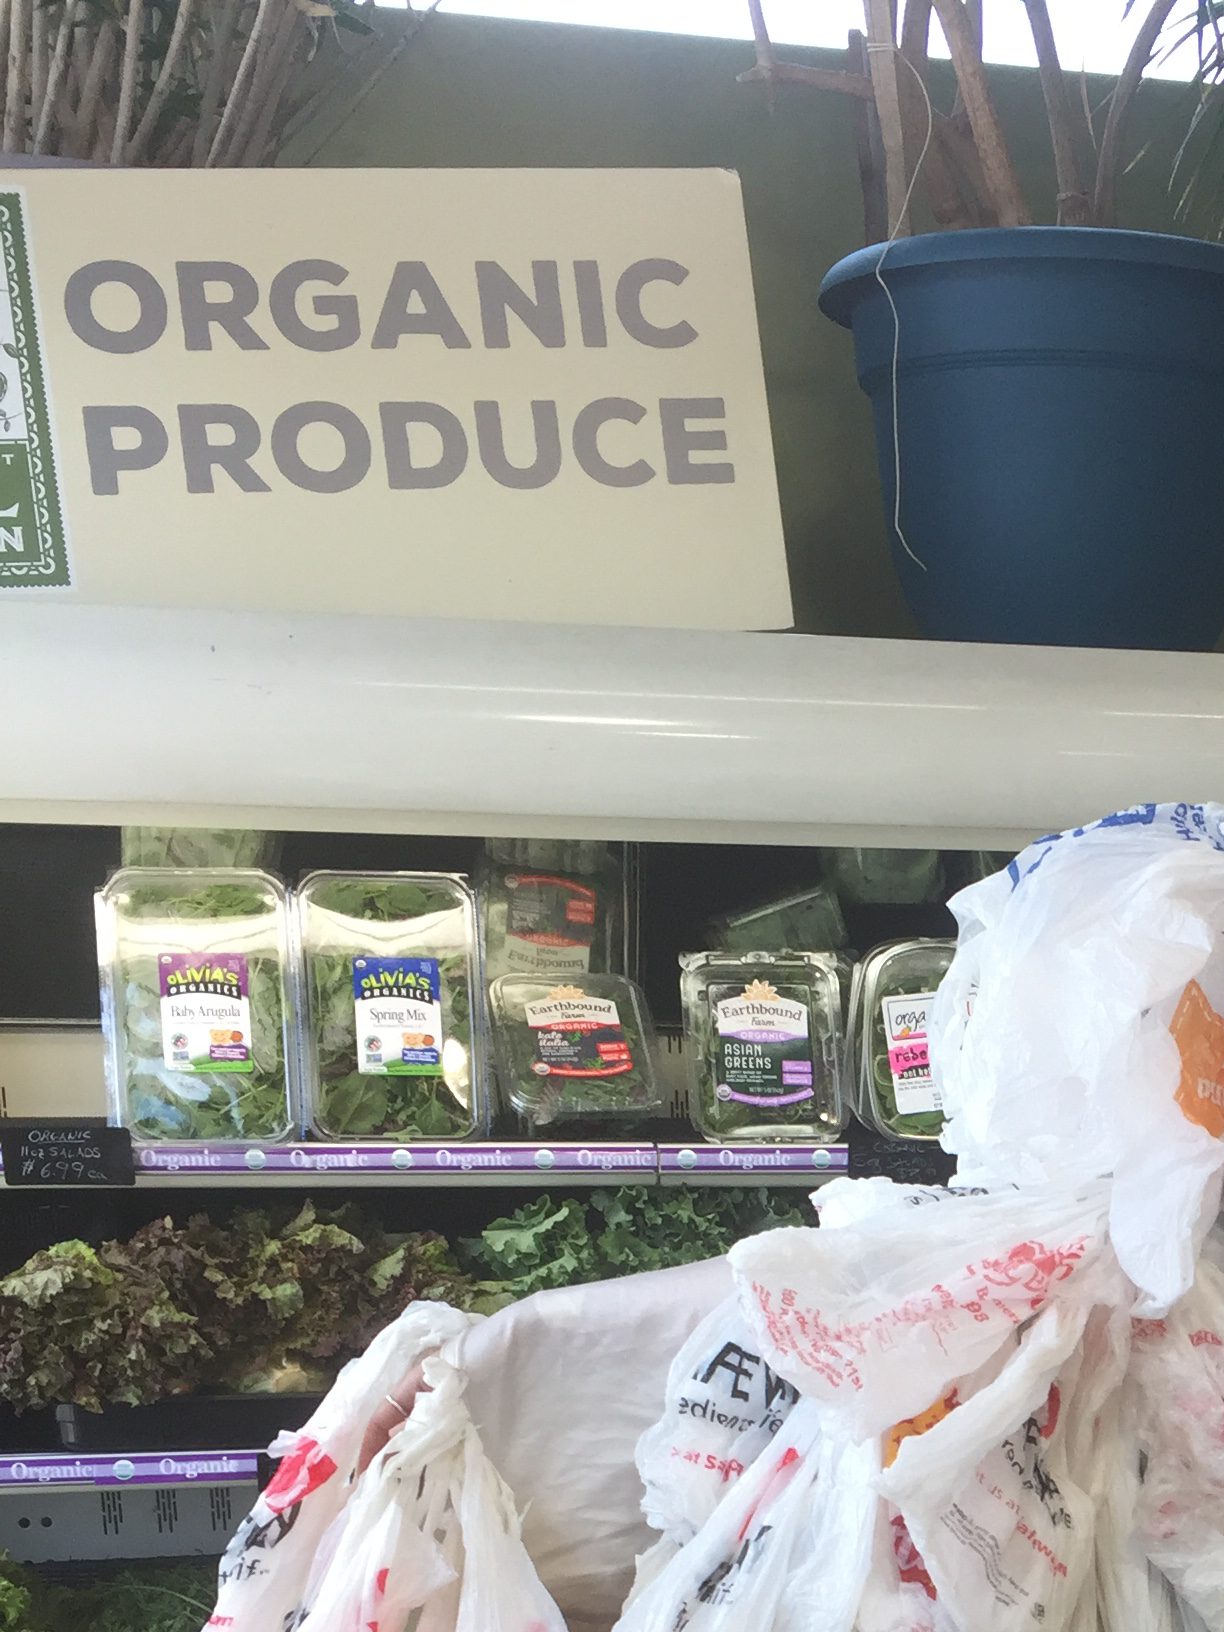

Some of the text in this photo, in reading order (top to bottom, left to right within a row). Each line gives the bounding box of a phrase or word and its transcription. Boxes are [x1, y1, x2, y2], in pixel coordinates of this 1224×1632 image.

[64, 258, 699, 354] ORGANIC
[82, 397, 736, 495] PRODUCE
[169, 983, 238, 996] ORGANICS
[363, 987, 430, 1001] ORGANICS
[171, 1003, 241, 1020] Baby Arugula
[370, 1007, 427, 1023] Spring Mix
[529, 1002, 612, 1015] Earthbound
[720, 1003, 803, 1021] Earthbound
[551, 1022, 599, 1030] ORGANIC
[751, 1016, 776, 1026] Farm
[740, 1032, 786, 1040] ORGANIC
[724, 1043, 762, 1057] ASIAN
[724, 1056, 772, 1069] GREENS
[28, 1129, 91, 1143] ORGANIC
[50, 1146, 101, 1158] SALADS
[140, 1149, 791, 1171] Organic Organic Organic Organic Organic
[10, 1456, 239, 1481] Organic Organic
